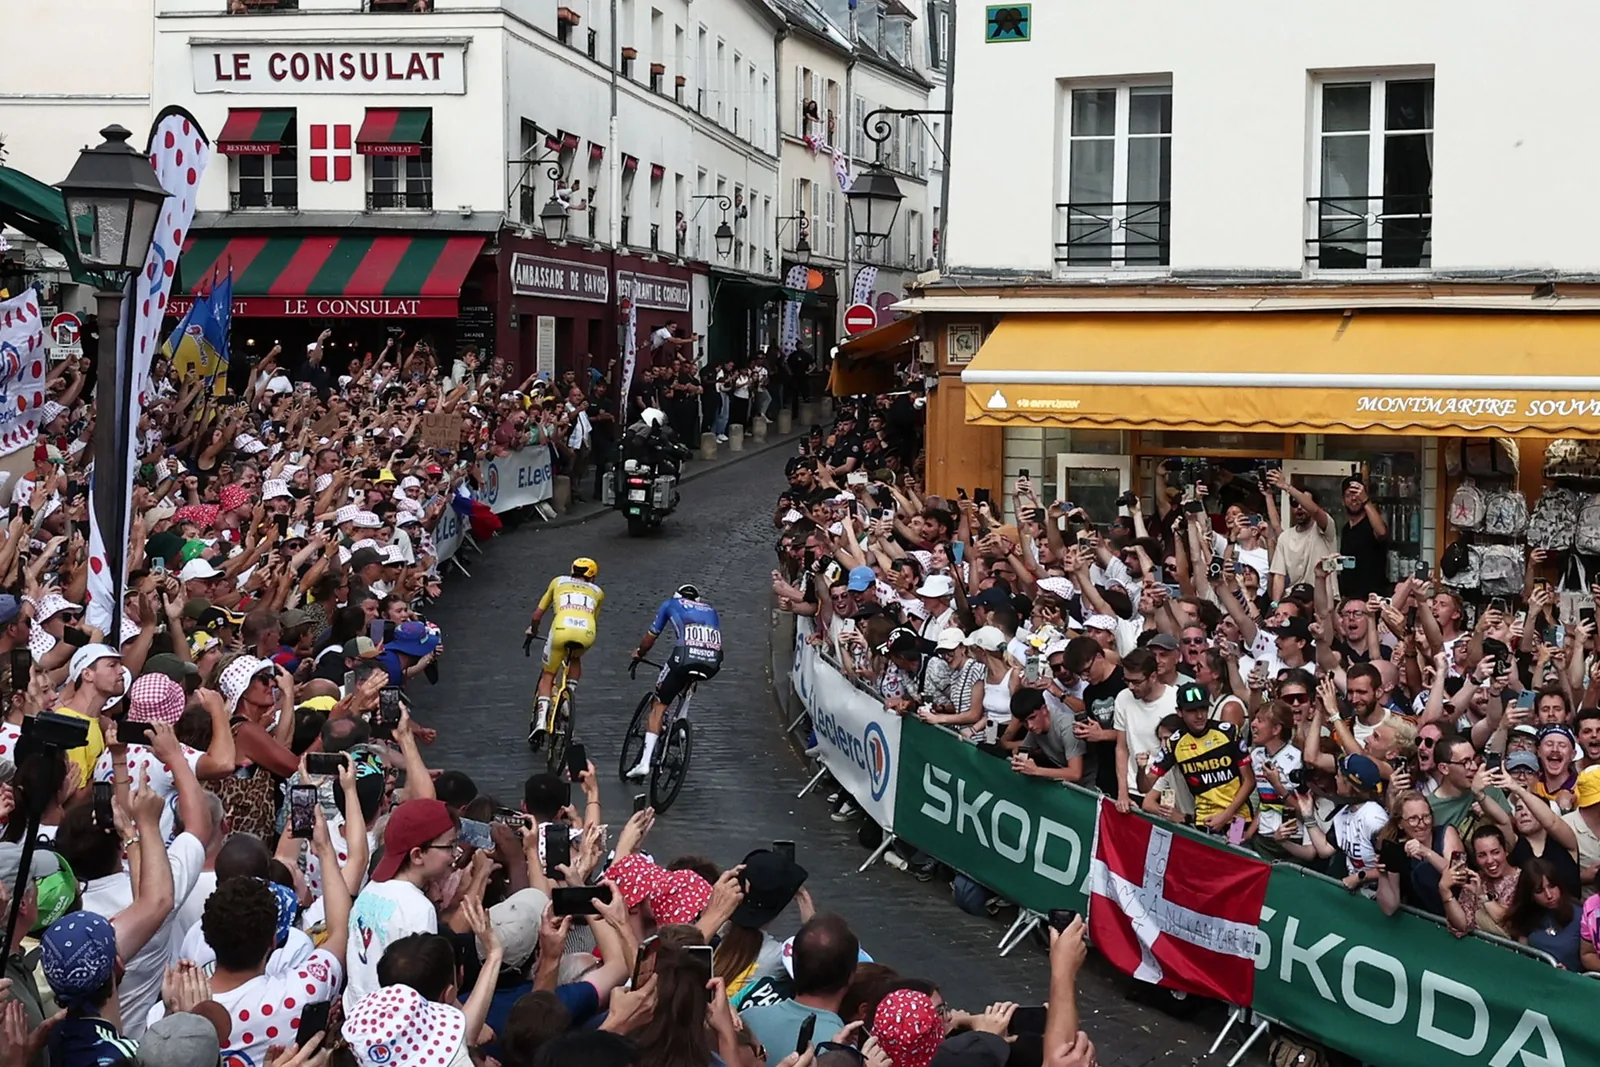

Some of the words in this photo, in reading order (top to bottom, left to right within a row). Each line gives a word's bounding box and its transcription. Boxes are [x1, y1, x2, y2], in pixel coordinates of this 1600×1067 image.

[213, 53, 251, 81] LE
[268, 52, 444, 81] CONSULAT
[226, 143, 272, 152] RESTAURANT
[363, 145, 374, 153] LE
[375, 145, 413, 153] CONSULAT
[515, 263, 565, 290] AMBASSADE
[569, 271, 580, 290] DE
[618, 279, 654, 301] RESTRANT
[284, 300, 306, 315] LE
[316, 299, 421, 316] CONSULAT
[1356, 396, 1517, 417] MONTMARTRE
[686, 626, 704, 641] 101
[705, 628, 721, 645] 101
[1183, 755, 1233, 775] JUMBO
[1201, 769, 1234, 785] VISMA
[920, 763, 1092, 897] SKOD
